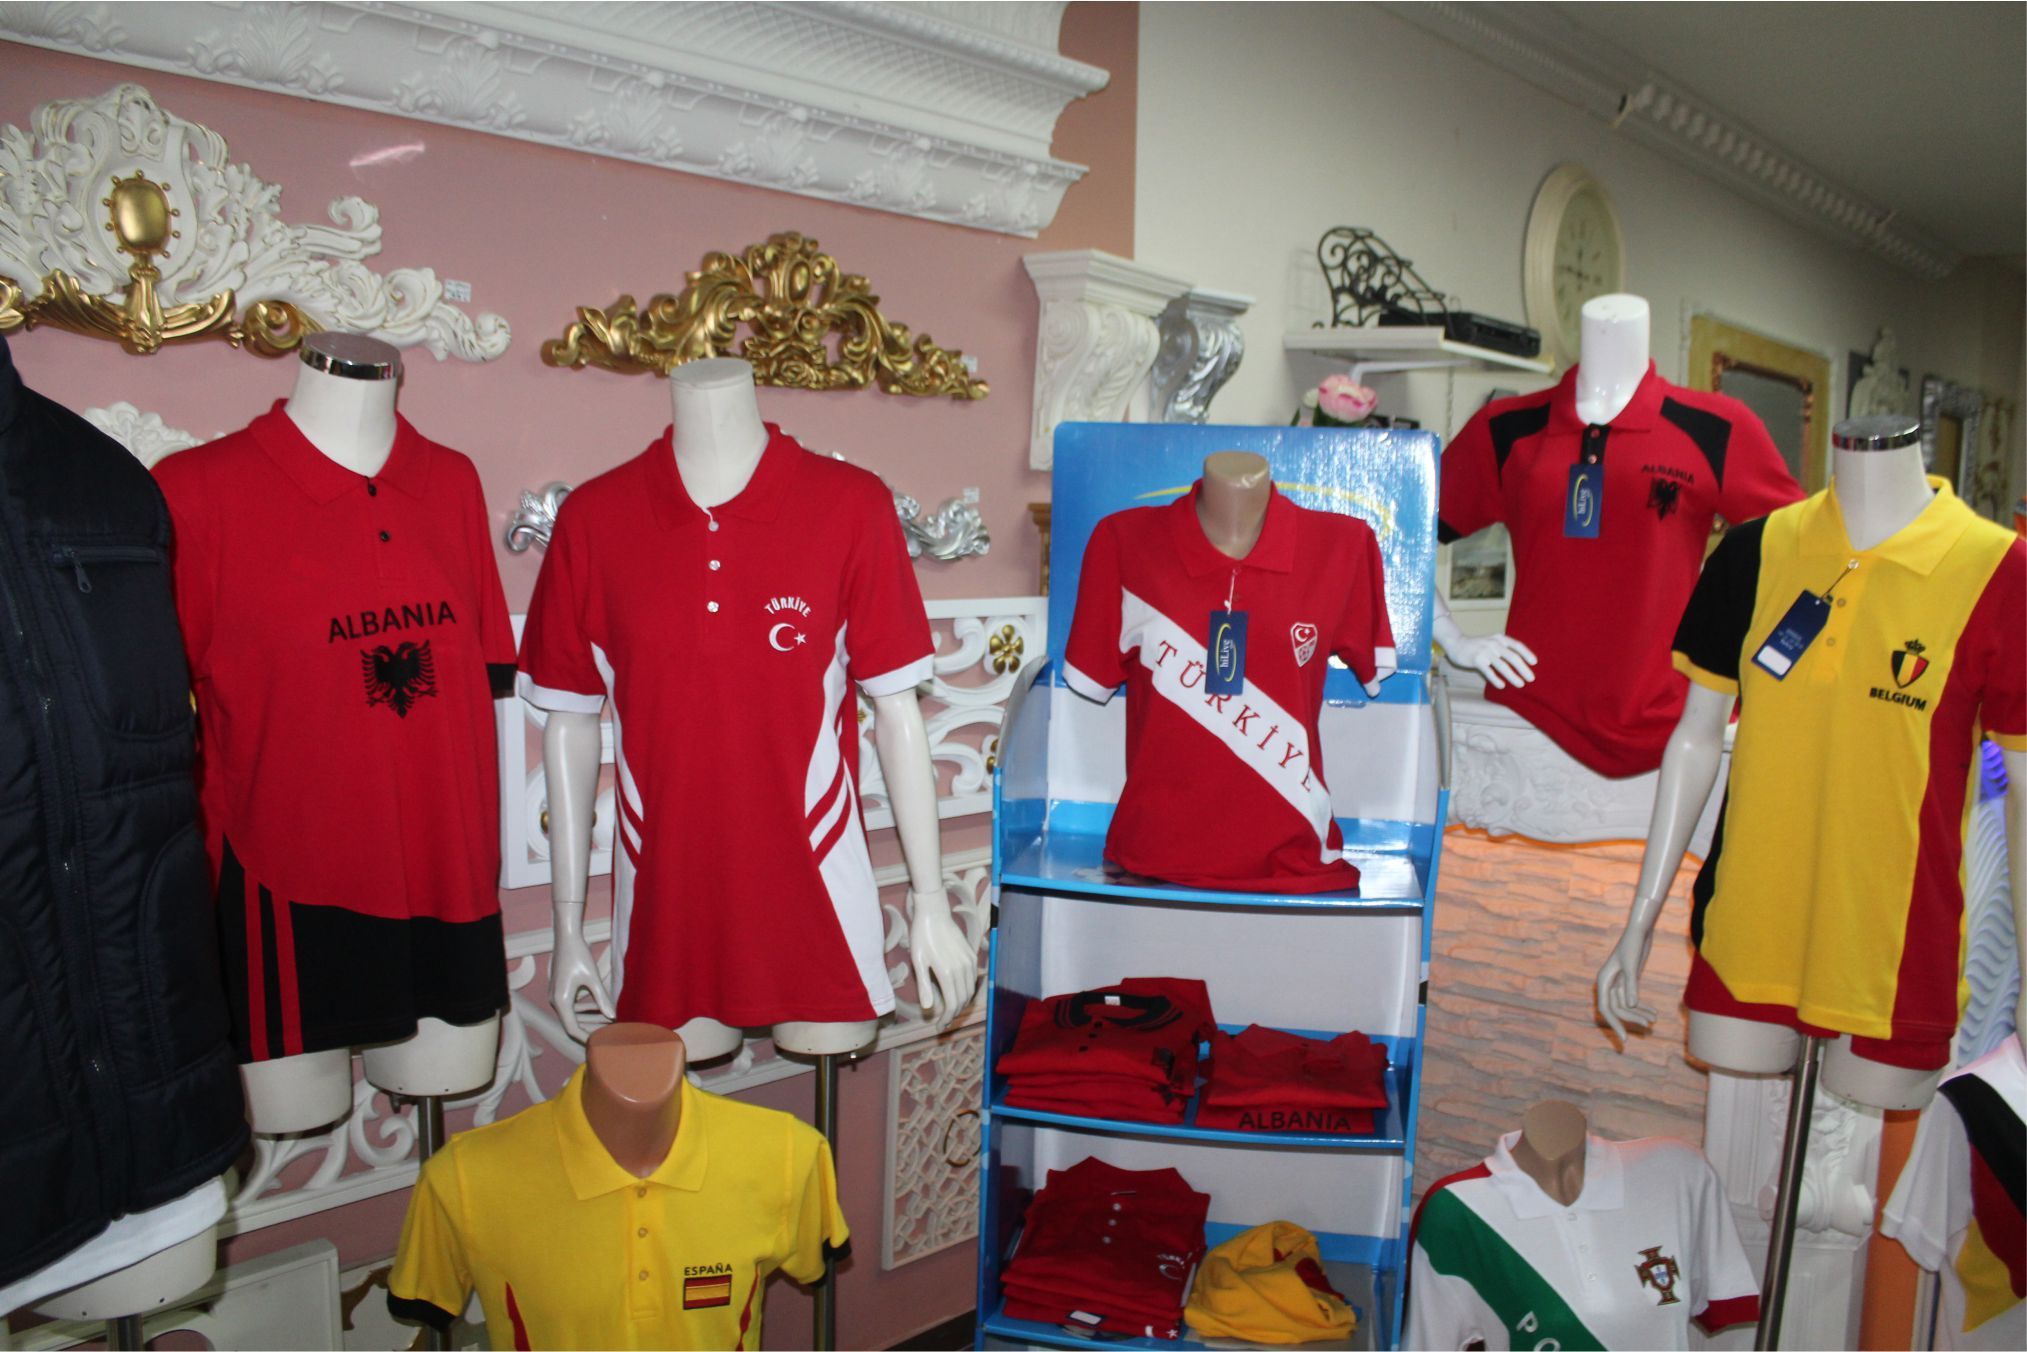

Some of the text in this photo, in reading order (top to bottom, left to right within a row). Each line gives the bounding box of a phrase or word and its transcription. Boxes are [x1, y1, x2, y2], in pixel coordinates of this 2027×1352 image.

[328, 601, 457, 643] ALBANIA
[1869, 687, 1927, 712] BELGIUM
[1238, 1111, 1352, 1130] ALBANIA
[684, 1262, 733, 1276] ESPAÑA
